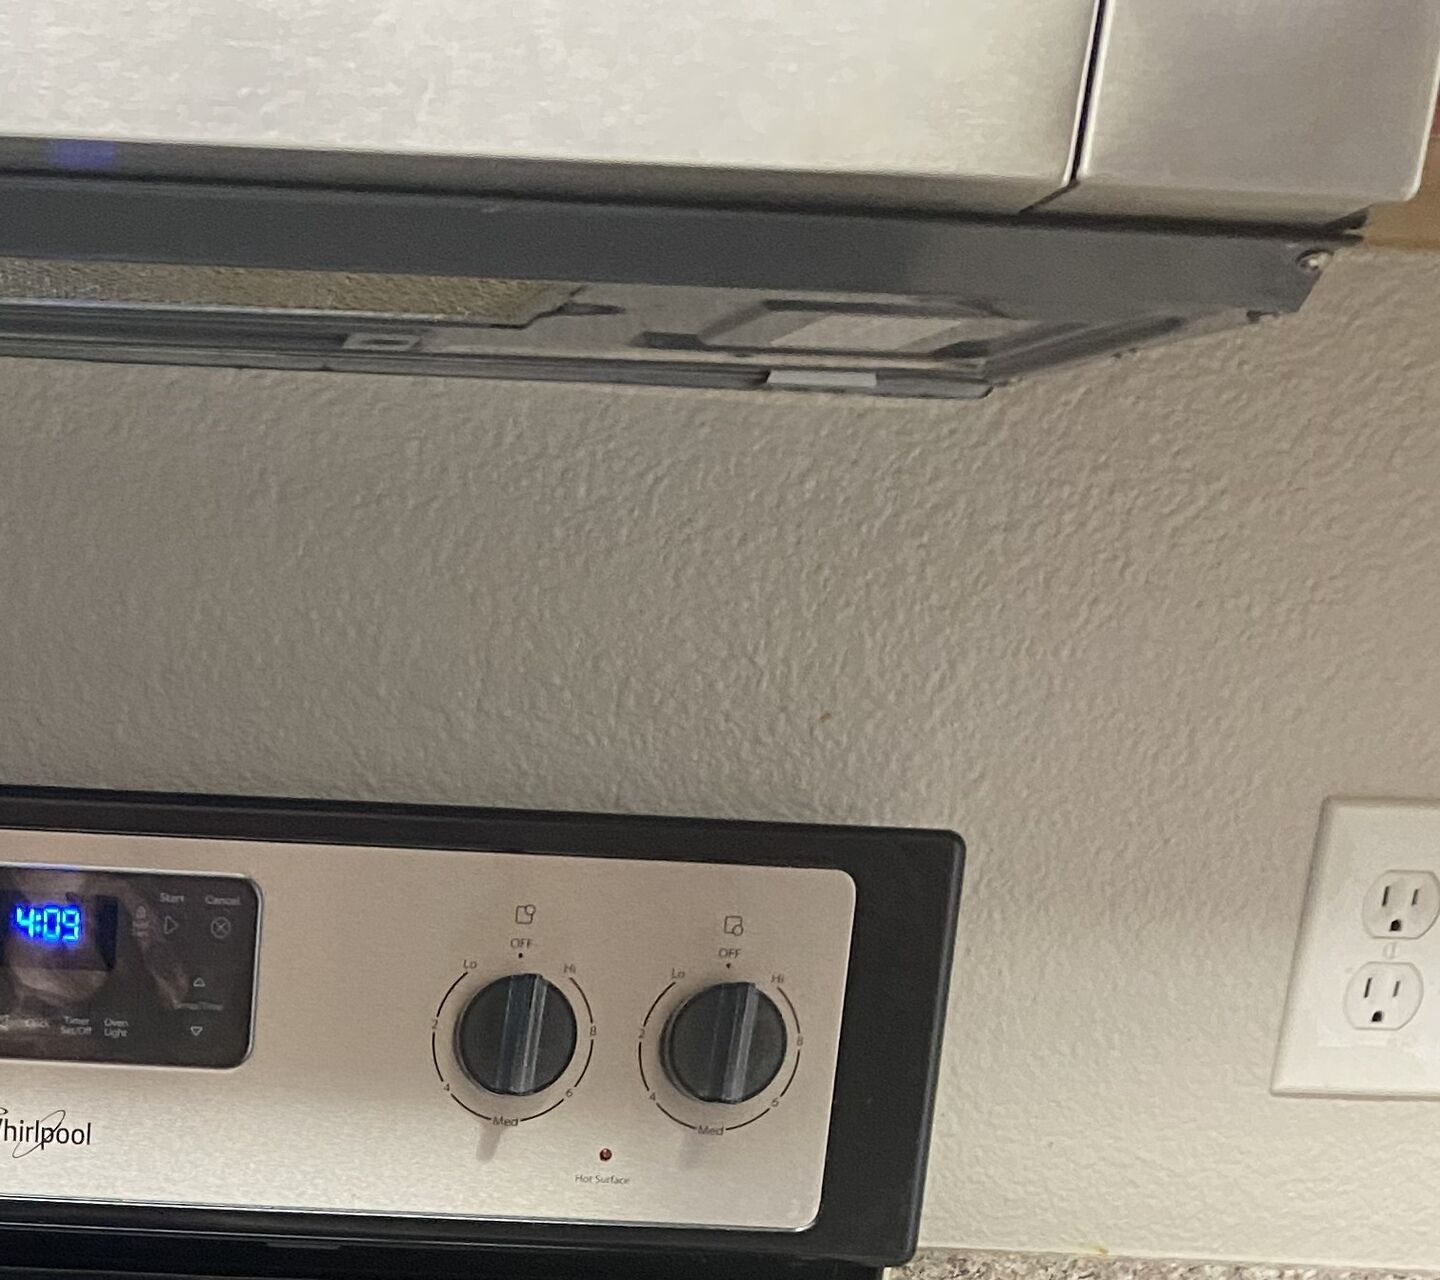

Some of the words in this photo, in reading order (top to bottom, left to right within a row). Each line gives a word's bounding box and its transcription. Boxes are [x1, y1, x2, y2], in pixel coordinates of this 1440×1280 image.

[16, 906, 80, 941] 4:09
[510, 938, 533, 949] OFF
[718, 947, 741, 959] OFF
[463, 959, 478, 969] Lo
[563, 963, 576, 974] Hi
[671, 968, 686, 979] Lo
[770, 974, 784, 984] Hi
[492, 1115, 518, 1127] Med
[697, 1122, 724, 1136] Med
[575, 1174, 593, 1184] Hot
[595, 1174, 630, 1185] Surface
